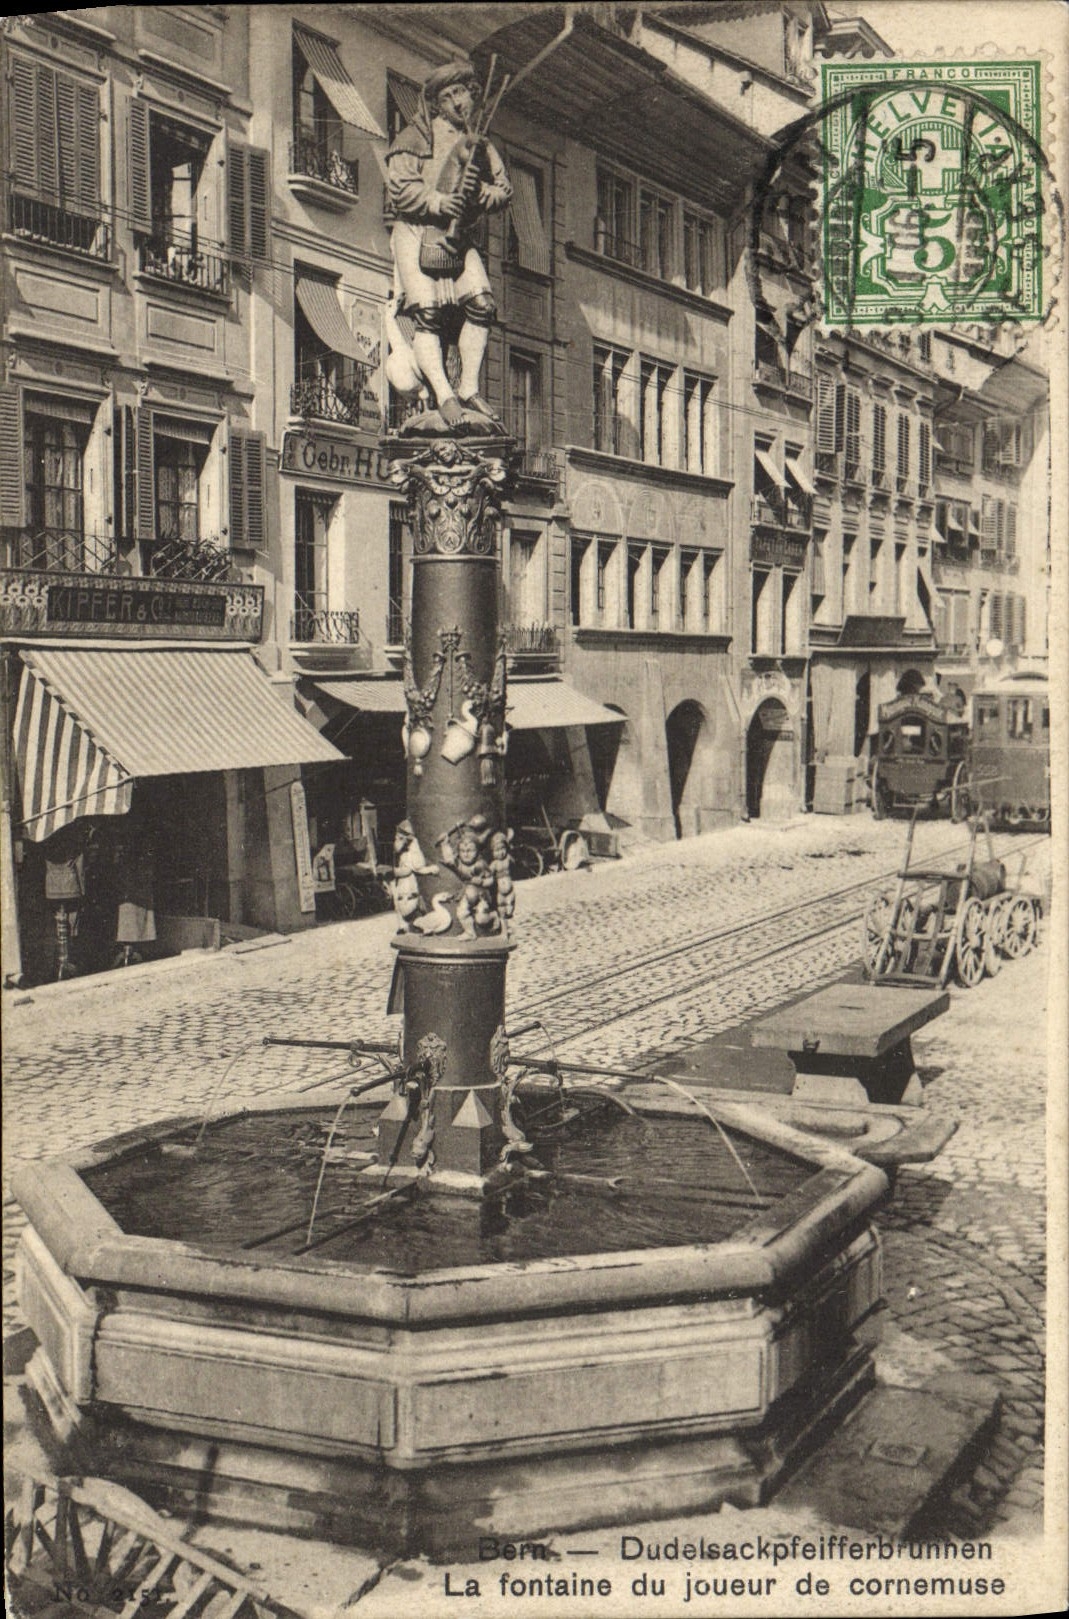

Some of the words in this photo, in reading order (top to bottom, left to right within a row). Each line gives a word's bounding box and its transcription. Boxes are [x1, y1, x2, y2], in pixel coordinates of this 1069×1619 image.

[892, 67, 970, 80] FRANCO
[913, 212, 955, 273] 5
[52, 591, 134, 620] KIPFER
